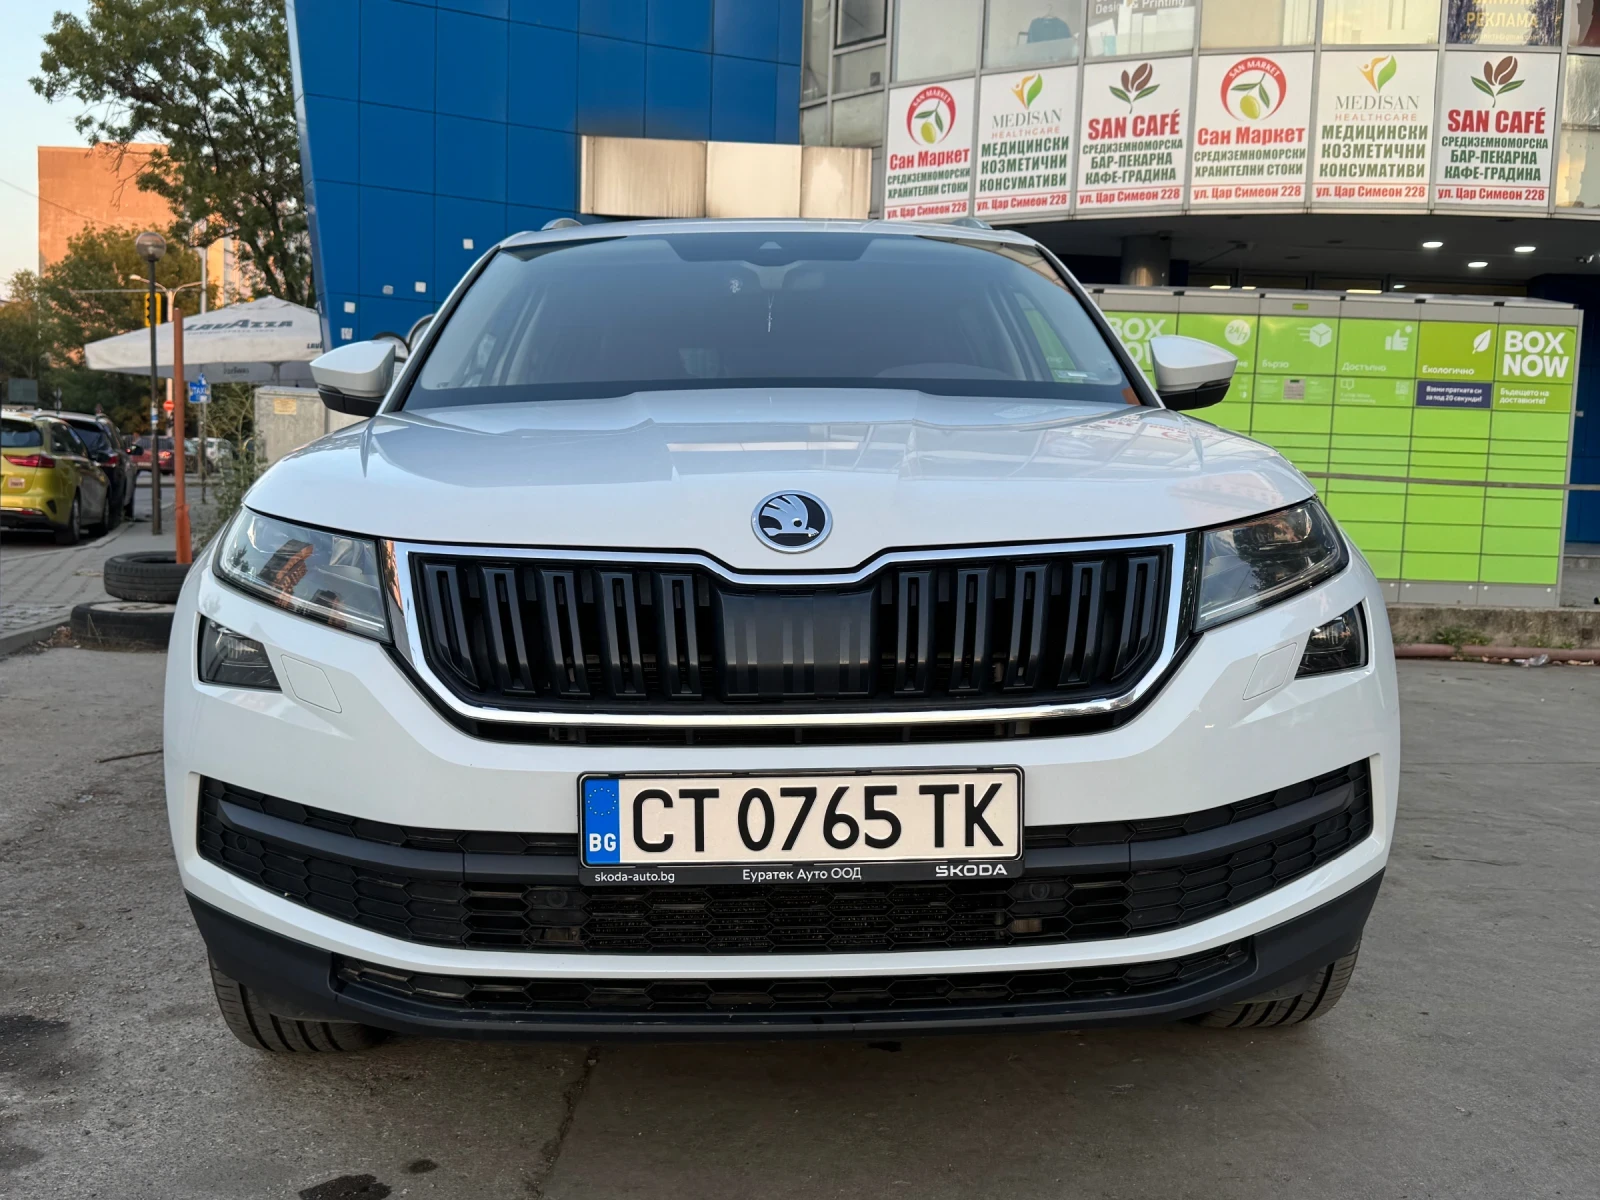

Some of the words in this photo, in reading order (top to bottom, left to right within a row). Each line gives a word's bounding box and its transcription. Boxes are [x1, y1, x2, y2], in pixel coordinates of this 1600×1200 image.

[1095, 2, 1121, 14] Desi
[1466, 12, 1538, 28] РЕКЛАМА
[1229, 64, 1246, 78] SAN
[1247, 60, 1281, 77] MARKET
[1335, 95, 1420, 110] MEDISAN
[992, 108, 1063, 129] MEDISAN
[1088, 117, 1127, 140] SAN
[1132, 109, 1180, 137] CAFÉ
[1335, 113, 1416, 121] HEALTHCARE
[1447, 109, 1490, 133] SAN
[1495, 107, 1546, 134] CAFÉ
[992, 126, 1060, 139] HEALTHCARE
[1198, 128, 1231, 145] Сан
[1235, 126, 1305, 145] Маркет
[1321, 125, 1428, 142] МЕДИЦИНСКИ
[981, 136, 1069, 158] МЕДИЦИНСКИ
[1082, 139, 1183, 155] СРЕДИЗЕМНОМОРСКА
[1321, 143, 1426, 159] КОЗМЕТИЧНИ
[1441, 136, 1548, 149] СРЕДИЗЕМНОМОРСКА
[890, 154, 914, 170] Сан
[918, 148, 970, 167] Маркет
[1091, 152, 1172, 169] БАР-ПЕКАРНА
[1194, 148, 1306, 163] СРЕДИЗЕМНОМОРСКИ
[1450, 149, 1537, 165] БАР-ПЕКАРНА
[981, 154, 1067, 175] КОЗМЕТИЧНИ
[1195, 165, 1264, 178] ХРАНИТЕЛНИ
[1267, 164, 1303, 175] СТОКИ
[1319, 163, 1425, 178] КОНСУМАТИВИ
[887, 167, 971, 185] СРЕДИЗЕМНОМОРСКИ
[1085, 168, 1176, 185] КАФЕ-ГРАДИНА
[1444, 165, 1541, 182] КАФЕ-ГРАДИНА
[888, 184, 939, 199] ХРАНИТЕЛНИ
[941, 182, 968, 194] СТОКИ
[979, 173, 1067, 192] КОНСУМАТИВИ
[1079, 194, 1094, 205] ул.
[1096, 192, 1115, 204] Цар
[1117, 190, 1158, 201] Симеон
[1161, 188, 1180, 200] 228
[1193, 189, 1209, 200] ул.
[1212, 188, 1232, 199] Цар
[1235, 187, 1278, 198] Симеон
[1281, 186, 1301, 197] 228
[1316, 187, 1332, 198] ул.
[1334, 186, 1355, 198] Цар
[1357, 186, 1402, 197] Симеон
[1404, 187, 1425, 197] 228
[1438, 189, 1454, 199] ул.
[1456, 188, 1476, 200] Цар
[1479, 188, 1522, 200] Симеон
[1524, 189, 1545, 200] 228
[887, 209, 898, 219] ул.
[900, 207, 915, 218] Цар
[917, 205, 950, 216] Симеон
[951, 202, 967, 213] 228
[977, 202, 989, 211] ул.
[991, 199, 1008, 211] Цар
[1011, 196, 1047, 209] Симеон
[1049, 194, 1067, 205] 228
[1110, 317, 1166, 340] BOX
[1228, 325, 1248, 341] 24/7
[1504, 330, 1565, 354] BOX
[1262, 359, 1289, 369] Бързо
[1342, 362, 1387, 372] Достъпно
[1422, 365, 1474, 376] Екологично
[1502, 354, 1569, 378] NOW
[1500, 388, 1539, 397] Бъдещето
[632, 788, 720, 852] CT
[737, 785, 902, 851] 0765
[918, 783, 1004, 848] TK
[589, 833, 617, 852] BG
[594, 872, 675, 884] skoda-auto.bg
[742, 869, 794, 882] Еуратек
[796, 868, 828, 881] Ауто
[831, 867, 862, 880] ООД
